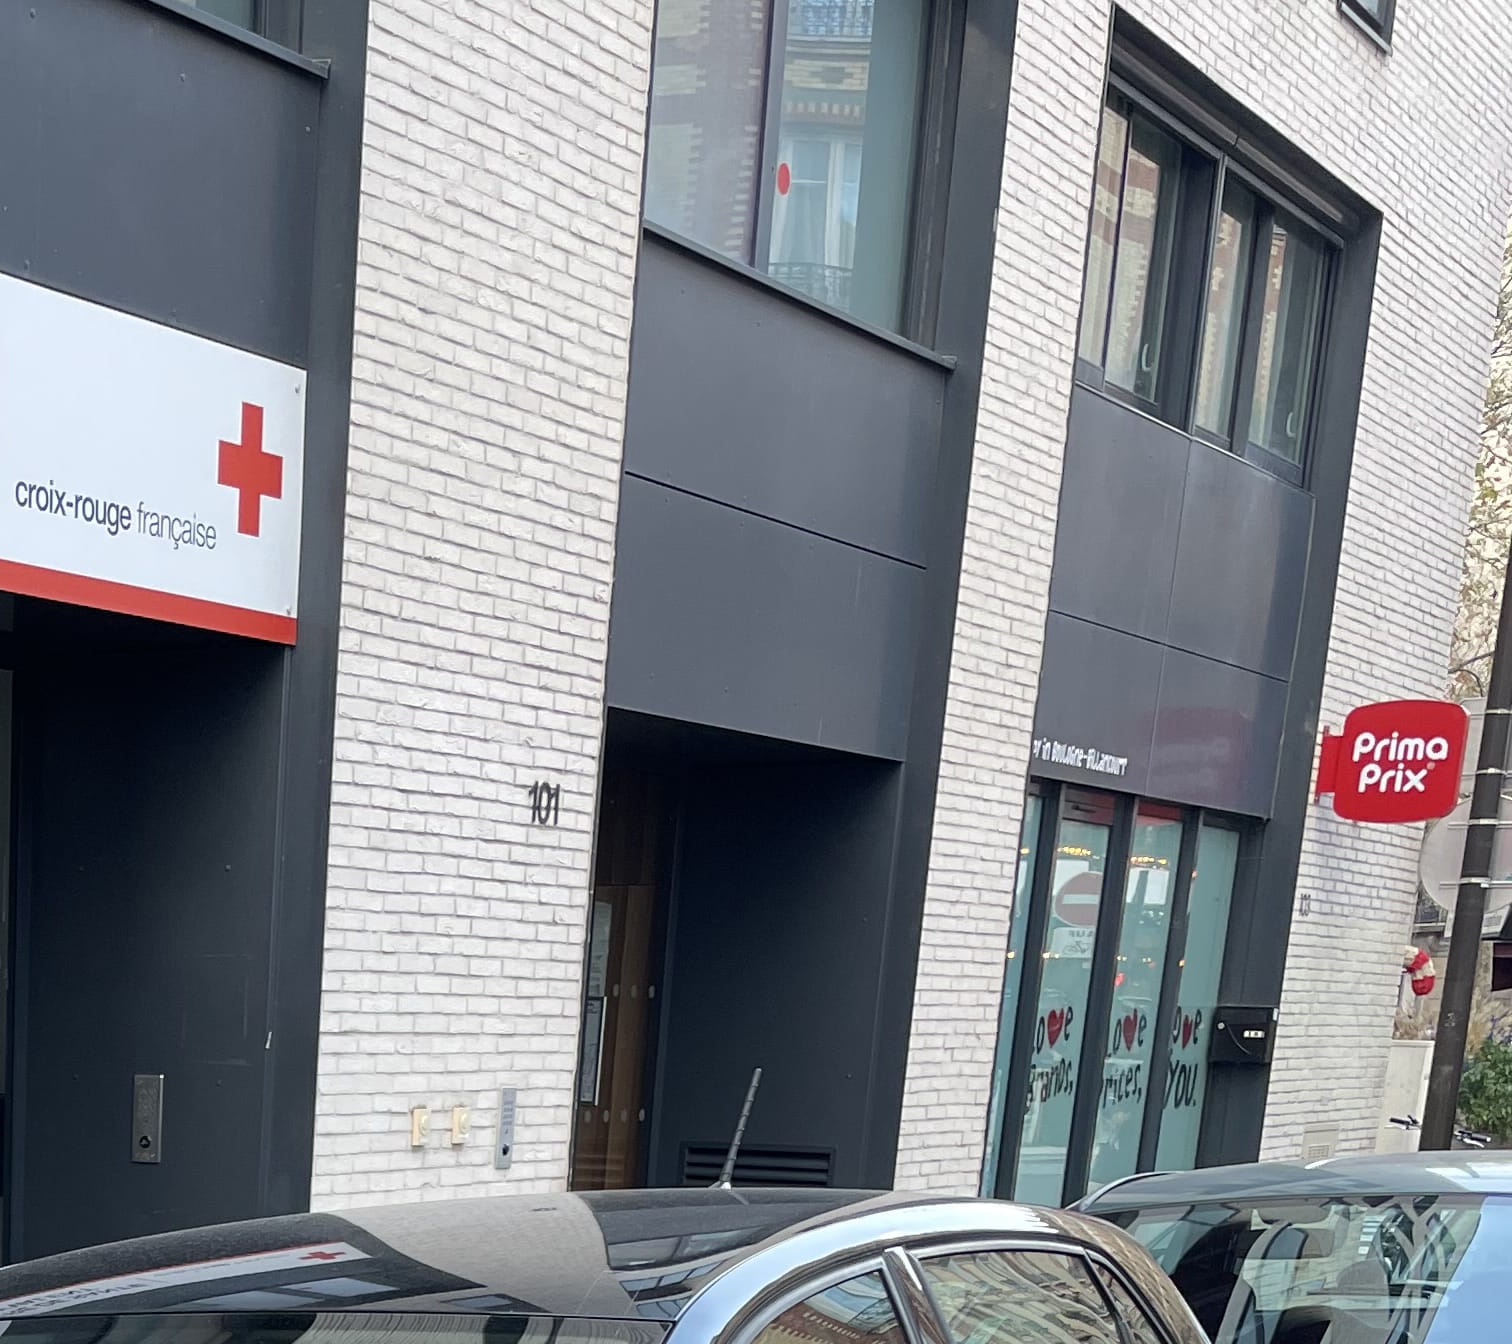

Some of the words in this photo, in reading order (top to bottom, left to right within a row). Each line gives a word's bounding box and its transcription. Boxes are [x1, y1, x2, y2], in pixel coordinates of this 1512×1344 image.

[15, 480, 132, 536] croix-rouge
[137, 501, 217, 550] française
[1351, 731, 1449, 762] Prima
[1357, 763, 1428, 793] Prix
[528, 780, 560, 826] 101
